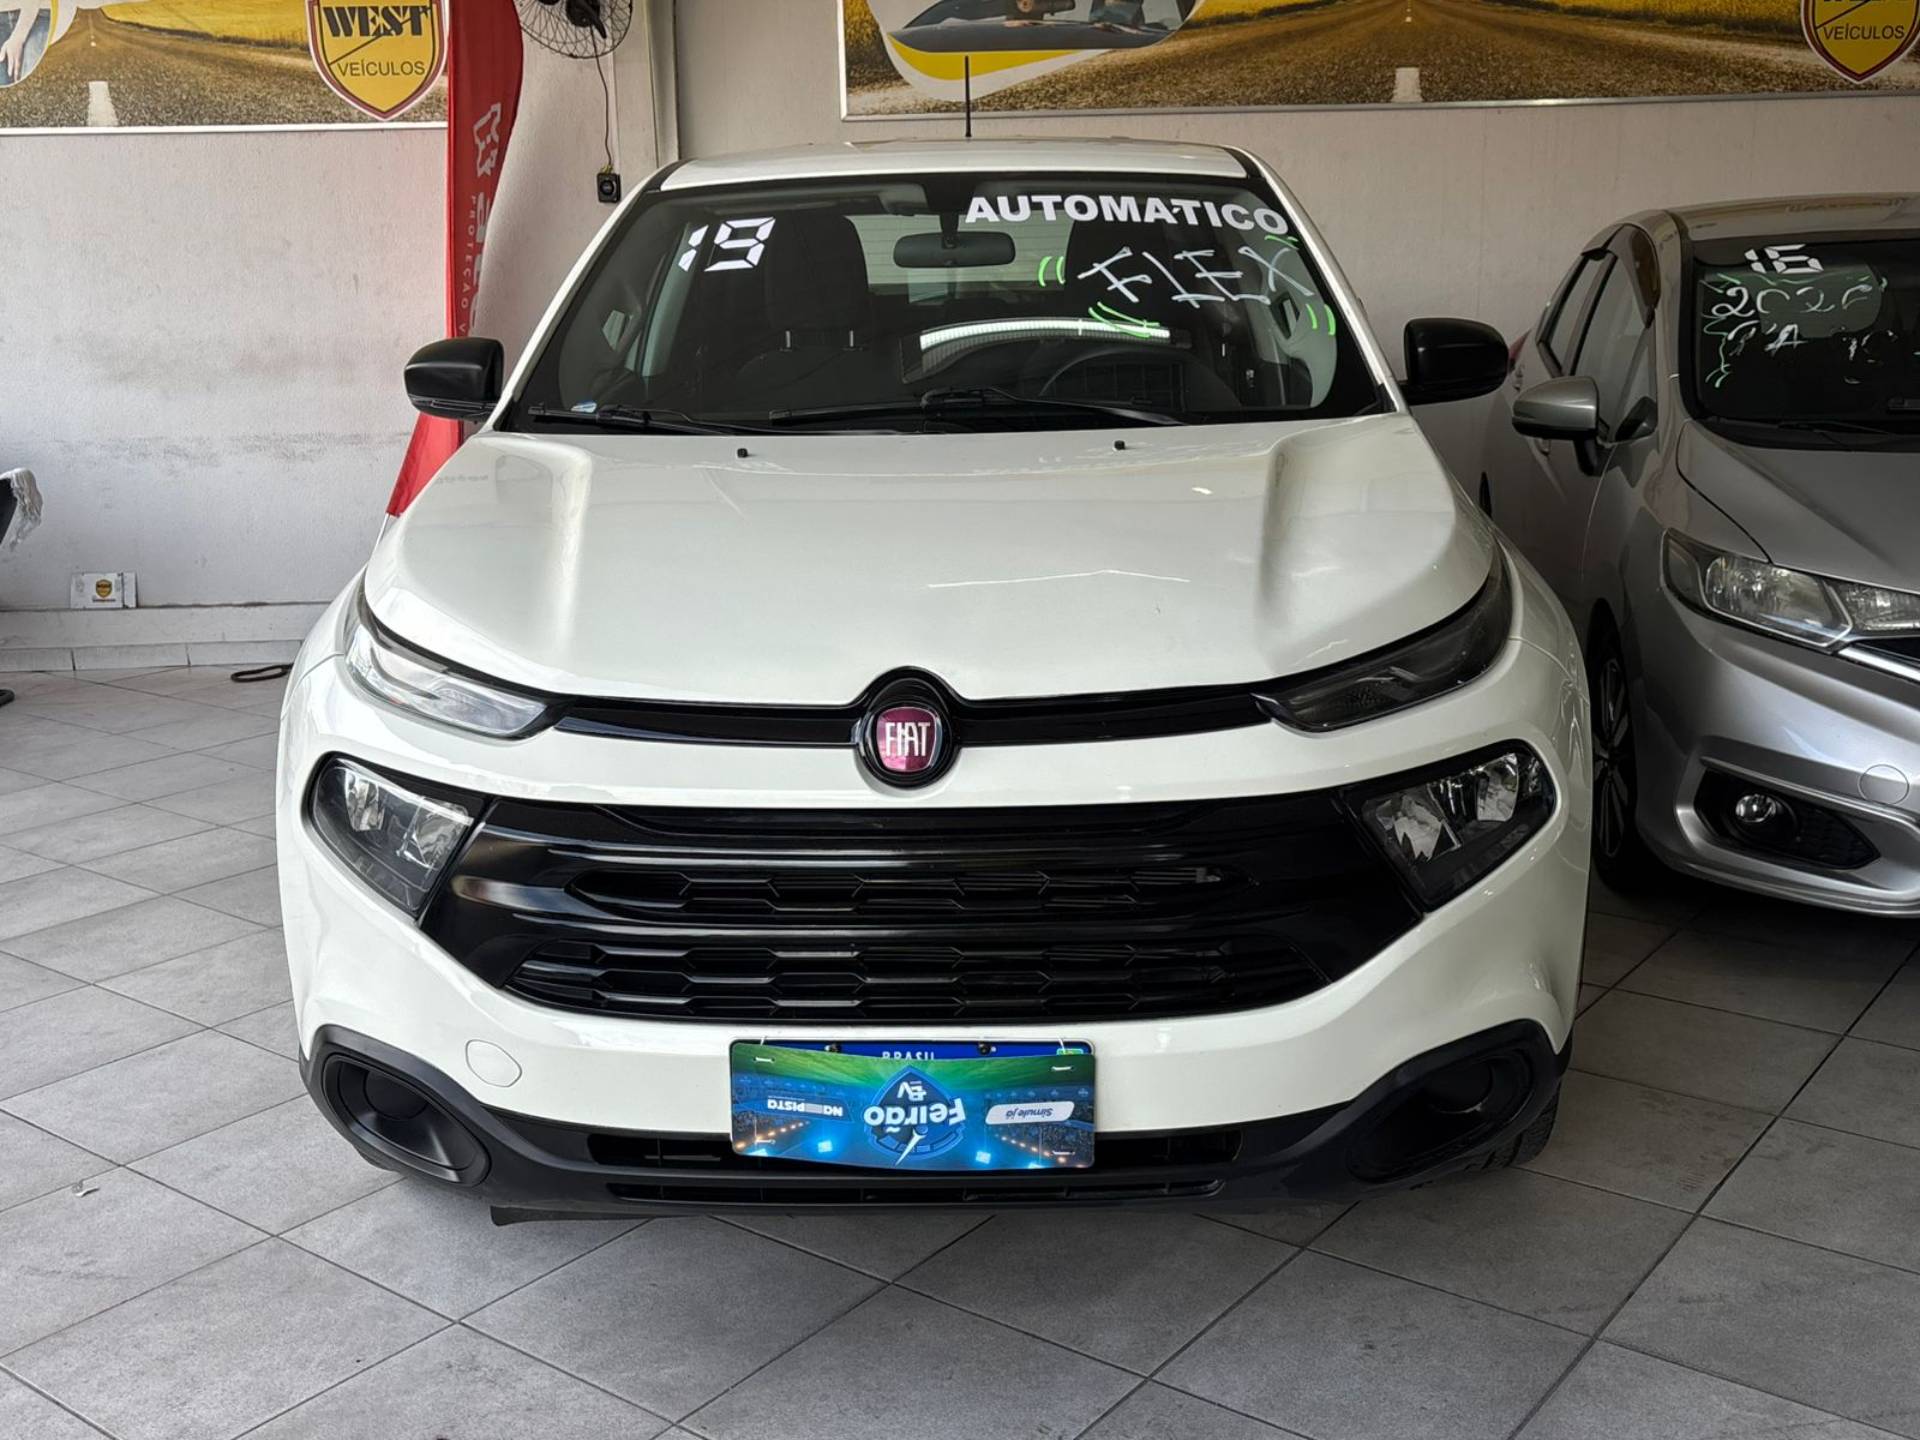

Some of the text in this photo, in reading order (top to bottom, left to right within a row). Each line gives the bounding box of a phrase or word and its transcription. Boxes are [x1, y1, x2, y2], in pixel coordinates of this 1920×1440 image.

[322, 5, 431, 37] WEST
[1823, 23, 1905, 40] VEÍCULOS
[336, 60, 426, 77] VEÍCULOS
[677, 216, 777, 273] 19
[1744, 243, 1825, 274] 16
[1076, 246, 1315, 308] FLEX
[884, 721, 931, 757] FIAT
[863, 1098, 966, 1134] Feirão
[1017, 1107, 1054, 1118] Simule
